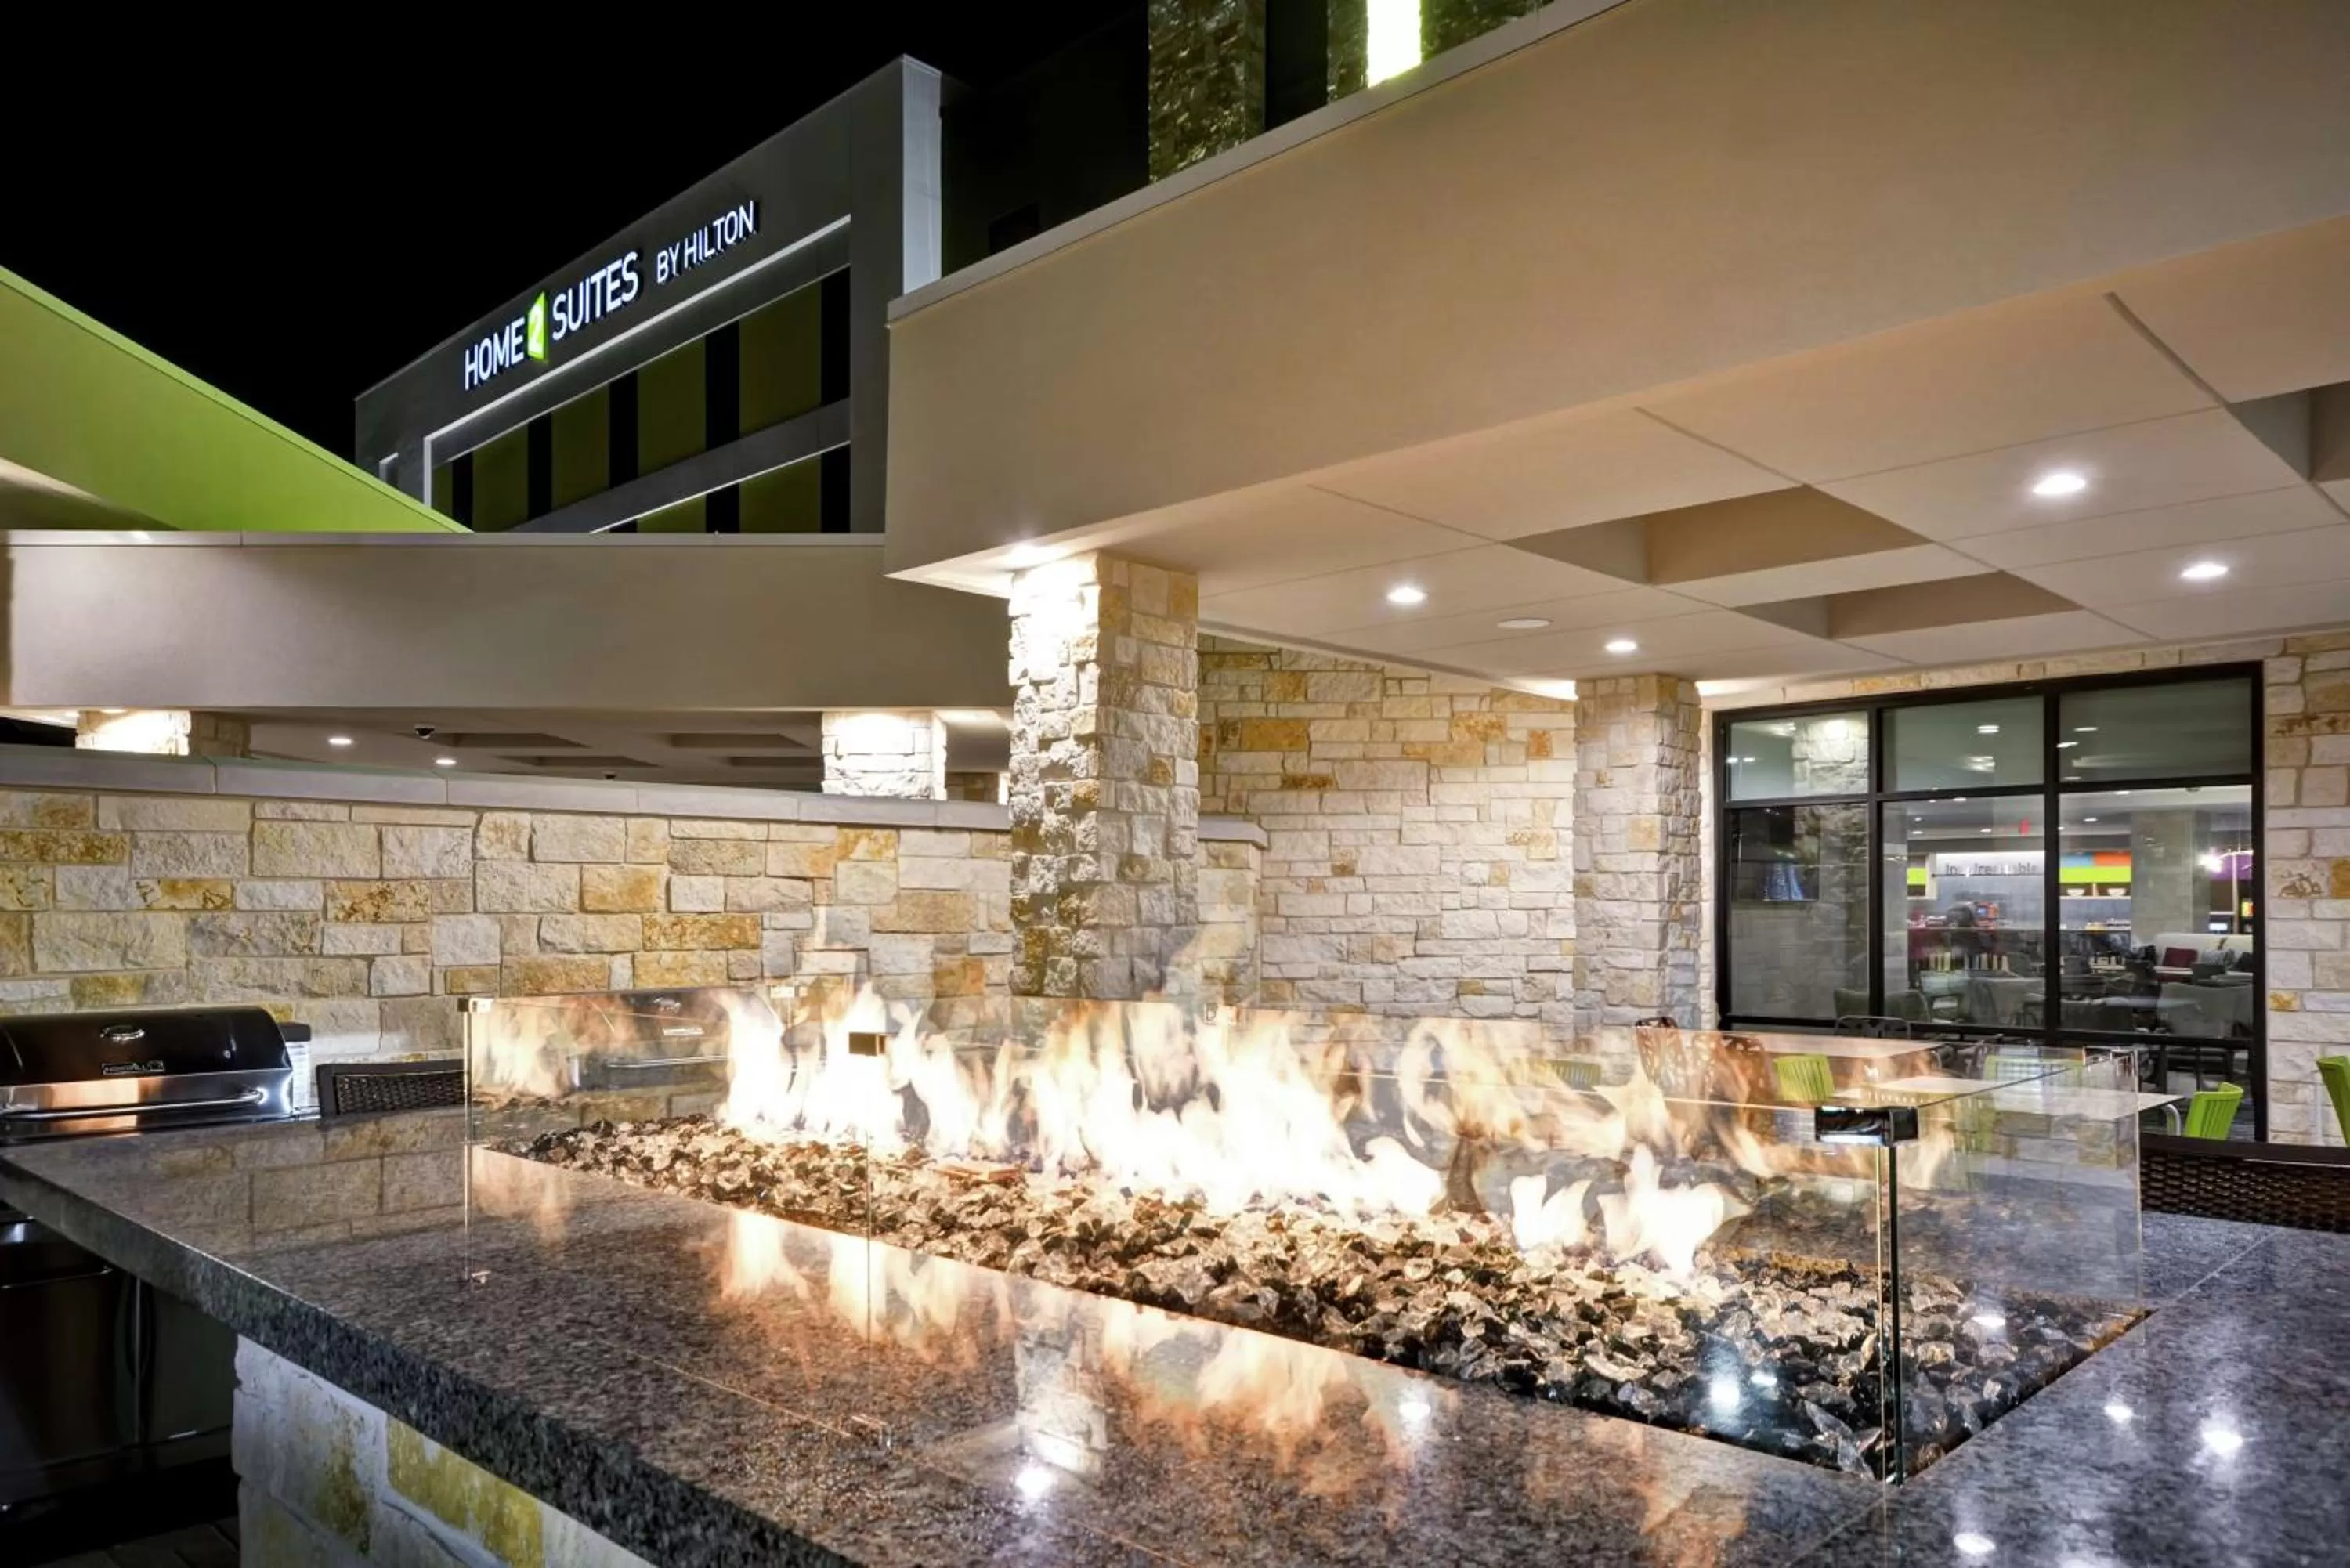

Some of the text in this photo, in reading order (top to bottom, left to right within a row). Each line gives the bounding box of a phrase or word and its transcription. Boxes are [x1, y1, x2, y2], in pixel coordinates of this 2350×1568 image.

[465, 201, 754, 390] HOME 2 SUITES BY HILTON
